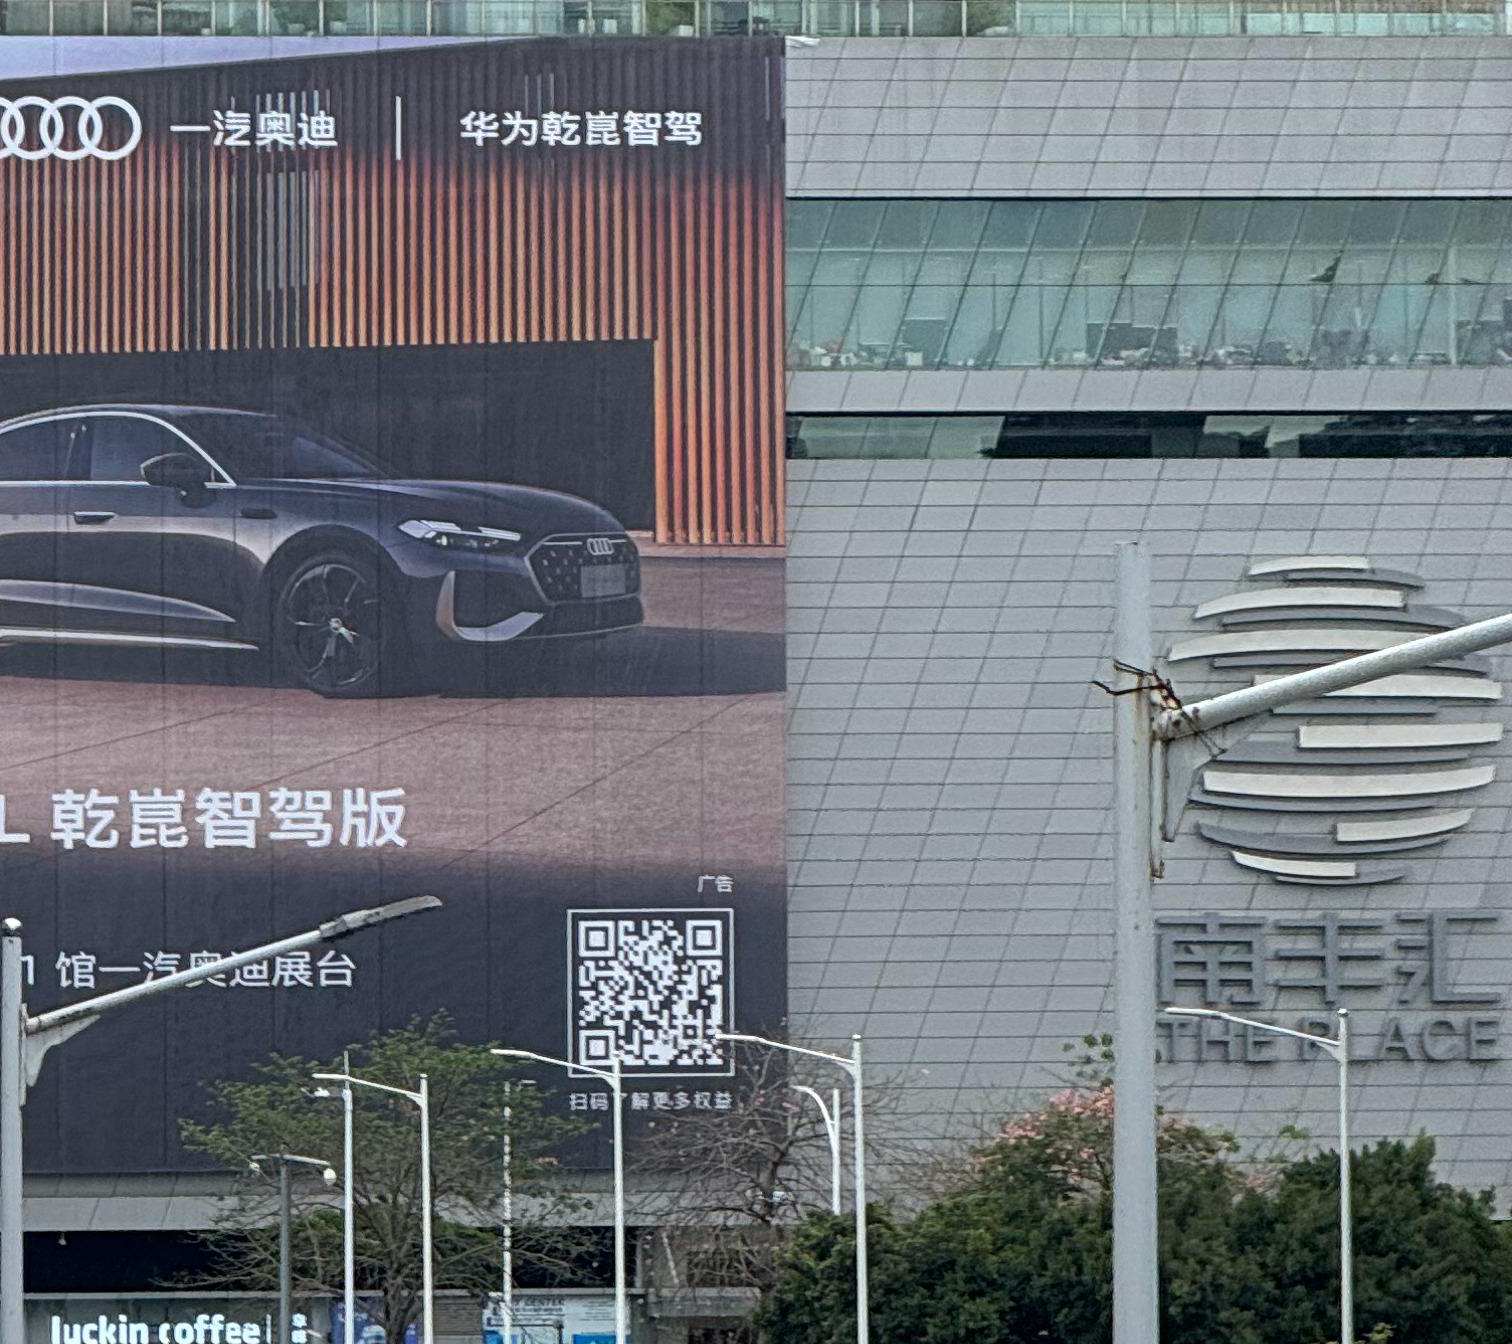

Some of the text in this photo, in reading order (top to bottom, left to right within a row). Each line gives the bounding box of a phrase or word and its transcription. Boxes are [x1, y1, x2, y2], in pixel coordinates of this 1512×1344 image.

[169, 109, 703, 148] 一汽奥迪 华为乾崑智驾
[50, 787, 407, 849] 乾崑智驾版
[697, 875, 734, 893] 广告
[1155, 911, 1501, 1006] 南丰汇
[1155, 1016, 1279, 1063] THE
[569, 1092, 734, 1111] 扫码解更多权益
